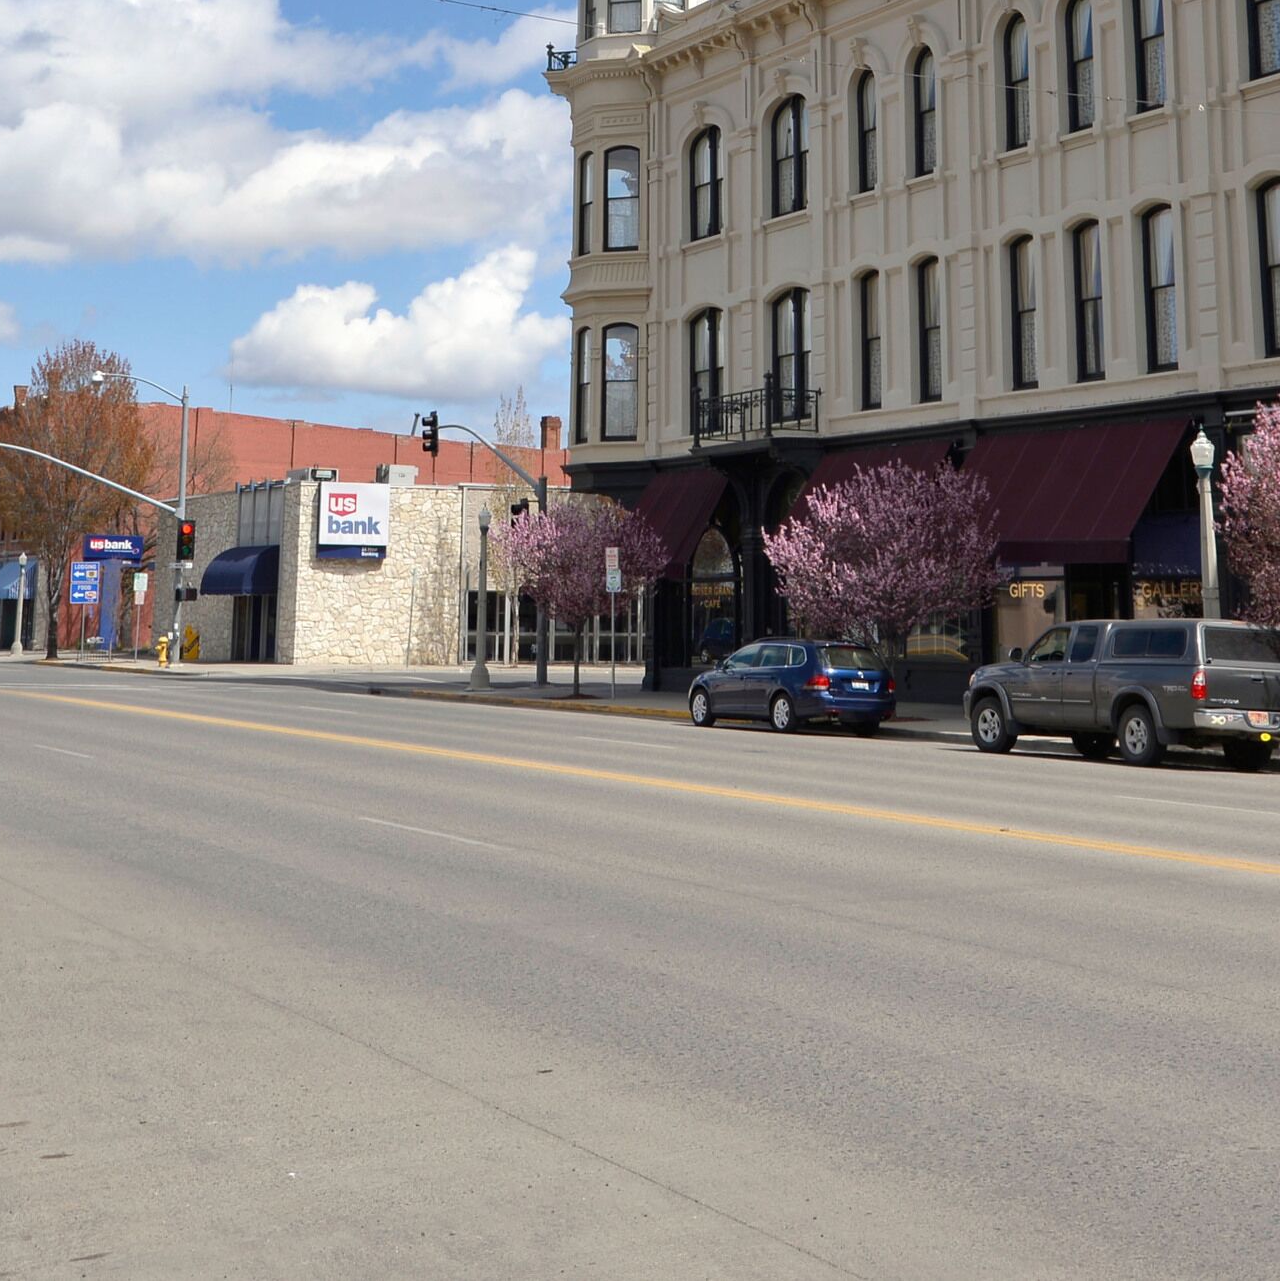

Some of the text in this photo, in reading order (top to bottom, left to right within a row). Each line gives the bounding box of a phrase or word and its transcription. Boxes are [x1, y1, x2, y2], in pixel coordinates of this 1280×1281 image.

[329, 497, 356, 512] us
[327, 516, 381, 535] bank
[104, 539, 133, 550] bank
[1009, 583, 1045, 598] GIFTS
[1141, 582, 1202, 598] GALLER
